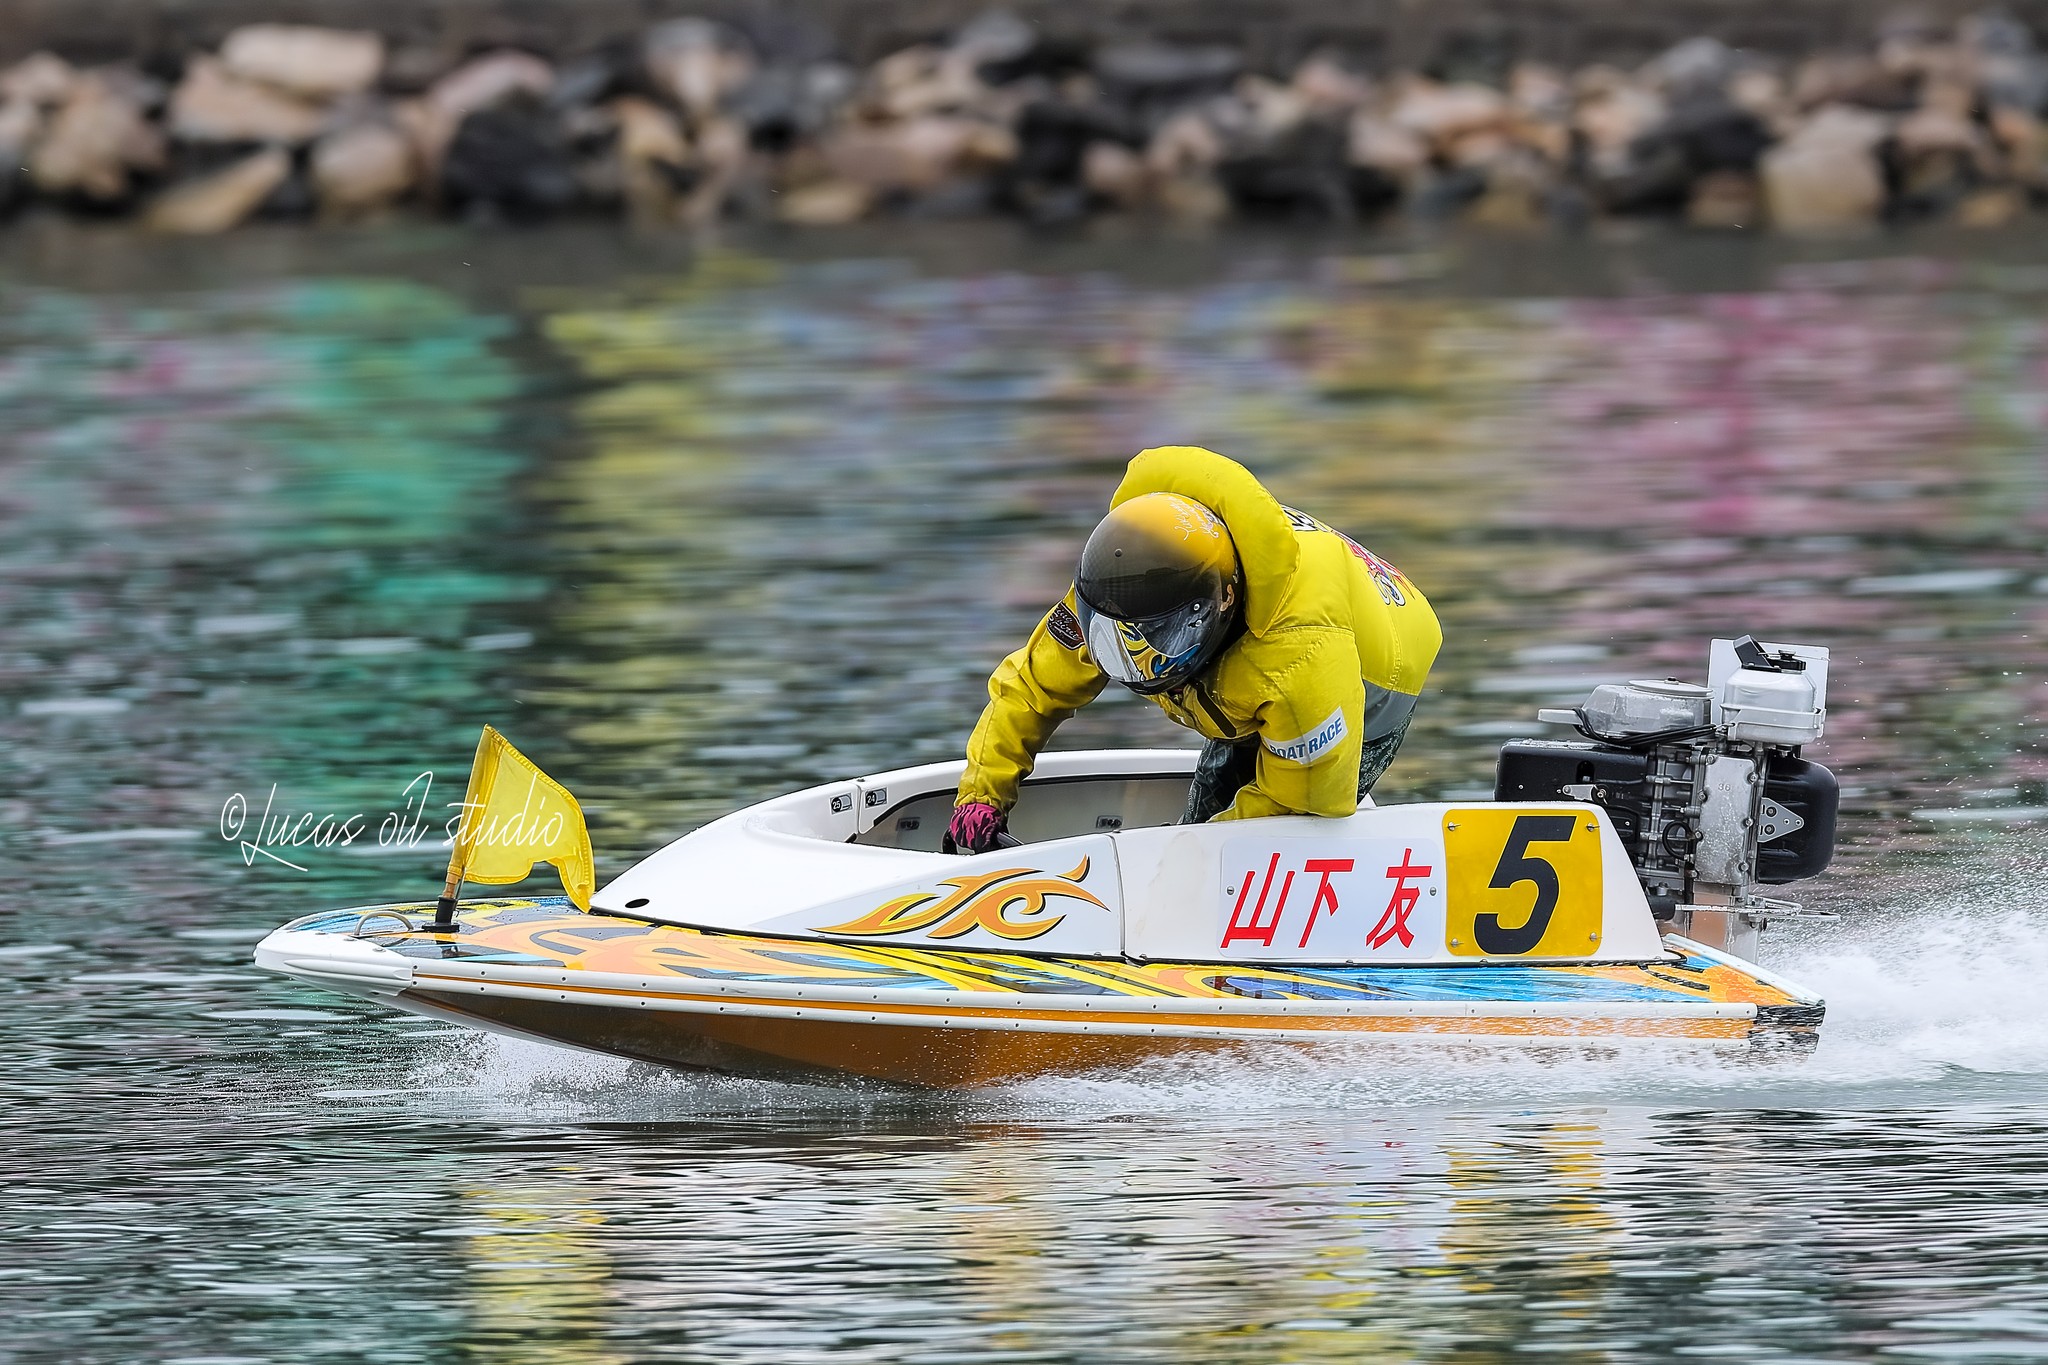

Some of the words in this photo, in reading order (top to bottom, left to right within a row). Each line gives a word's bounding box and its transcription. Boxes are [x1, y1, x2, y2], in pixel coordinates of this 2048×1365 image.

[1308, 717, 1343, 754] RACE
[832, 800, 841, 810] 25
[1473, 815, 1578, 956] 5
